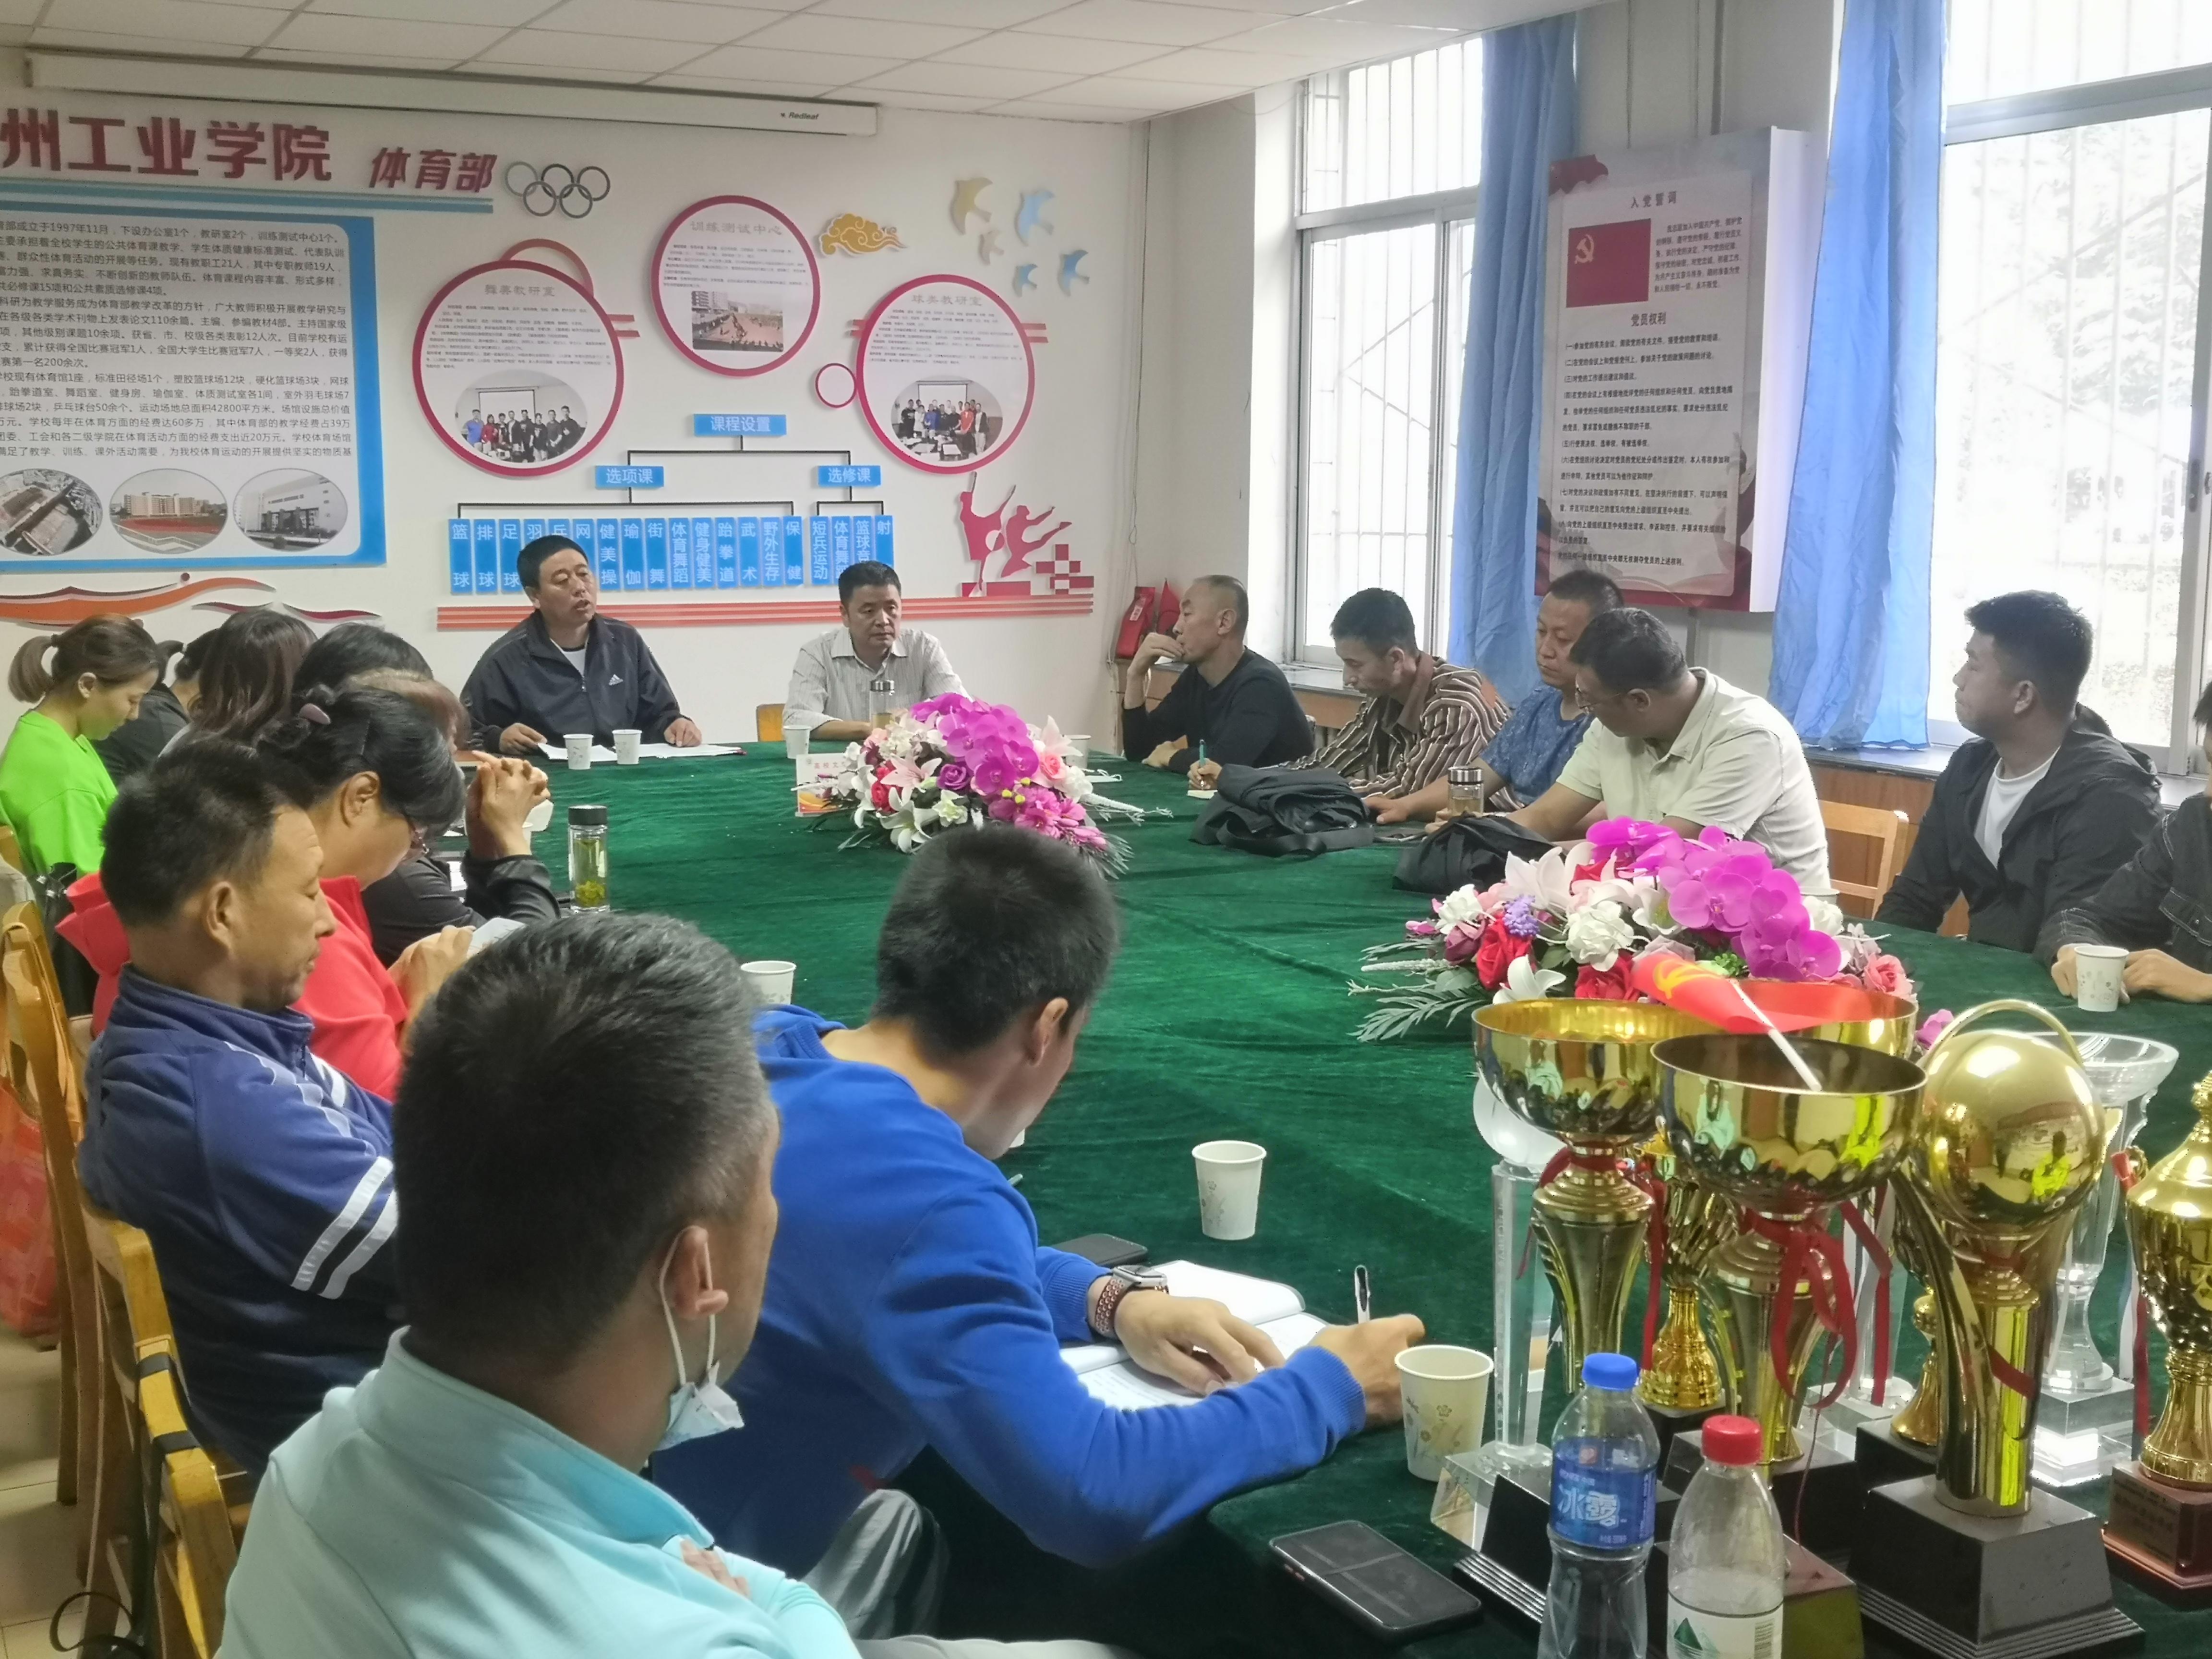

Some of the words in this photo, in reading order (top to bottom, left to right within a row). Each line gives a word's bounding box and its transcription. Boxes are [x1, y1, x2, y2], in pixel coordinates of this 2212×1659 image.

[1, 108, 332, 181] 州工业学院
[369, 146, 497, 192] 体育部
[690, 220, 782, 235] 训练测试中心
[1631, 192, 1677, 208] 入党誓词
[911, 294, 983, 306] 球类教研室
[1631, 312, 1667, 326] 党员权利
[710, 416, 771, 432] 课程设置
[606, 468, 654, 484] 选项课
[828, 468, 871, 483] 选修课
[452, 524, 469, 588] 篮球
[477, 525, 494, 587] 排球
[502, 524, 520, 587] 足球
[600, 523, 617, 585] 健美操
[624, 523, 641, 585] 瑜伽
[648, 523, 665, 584] 街舞
[672, 522, 688, 583] 体育舞蹈
[695, 522, 712, 582] 健身健美
[718, 523, 734, 582] 跆拳道
[741, 522, 757, 581] 武术
[763, 522, 780, 581] 野外生存
[786, 521, 802, 580] 保健
[812, 520, 828, 580] 短兵运动
[1557, 1484, 1620, 1528] 冰露
